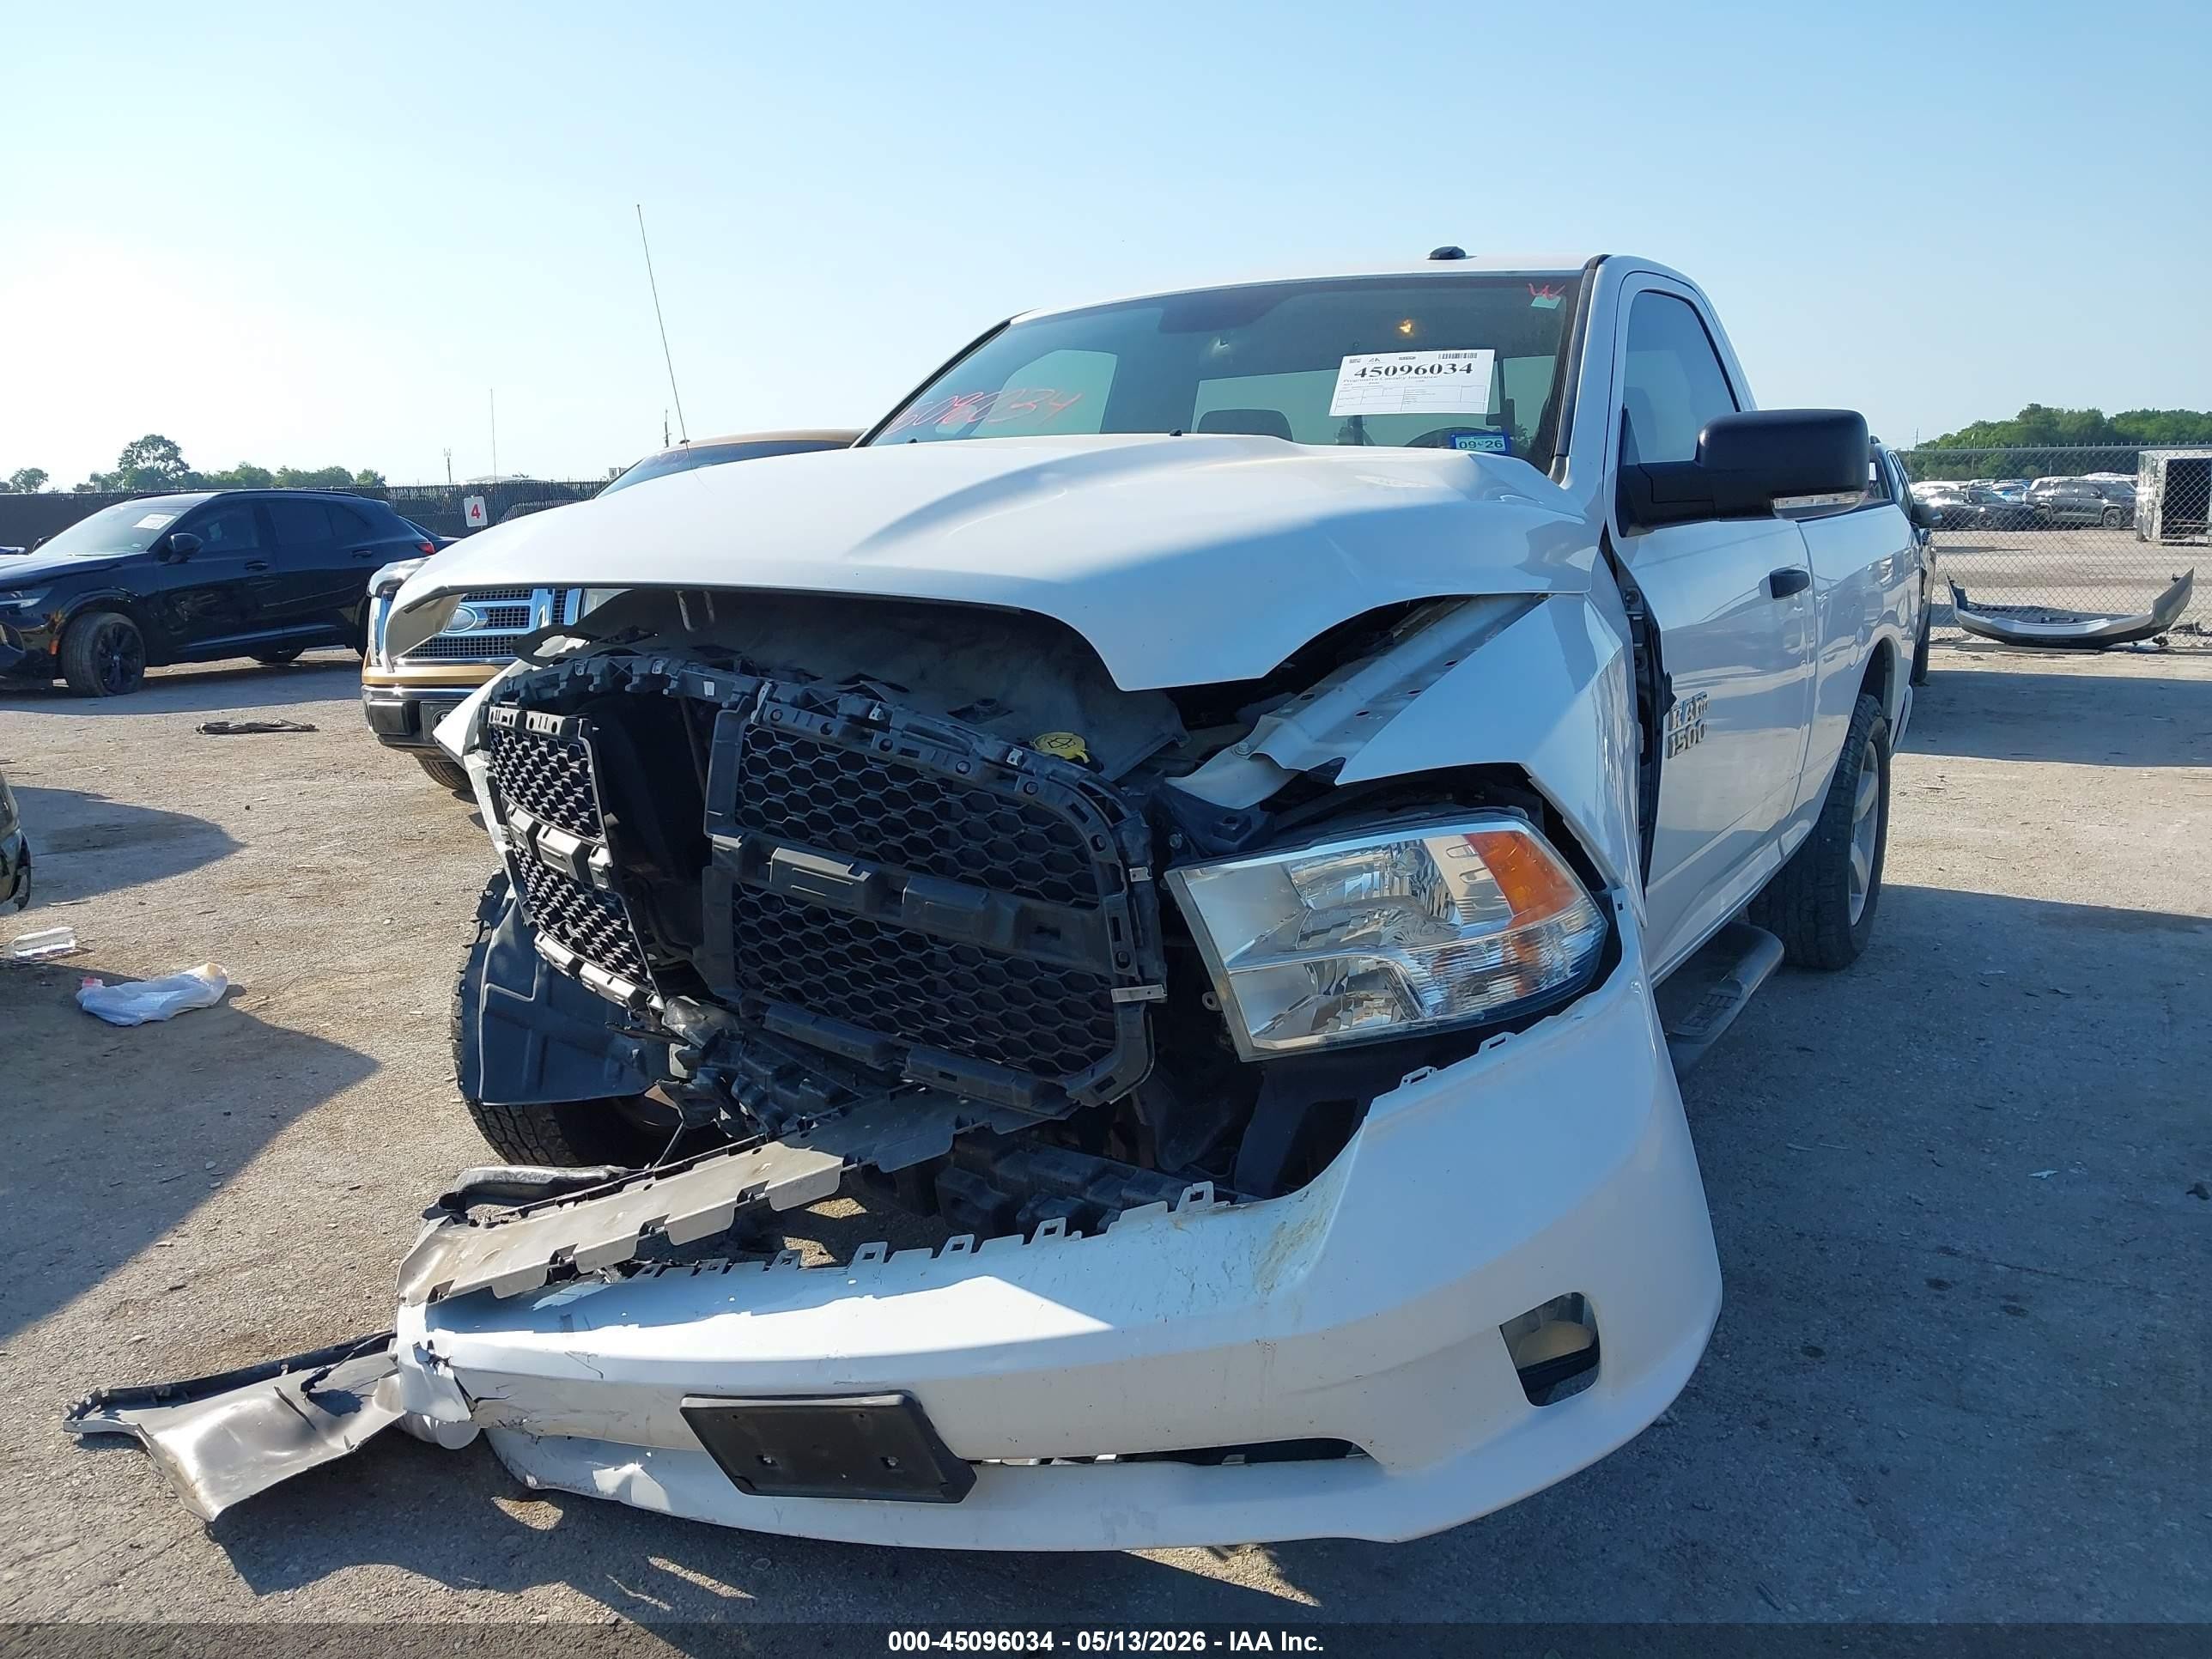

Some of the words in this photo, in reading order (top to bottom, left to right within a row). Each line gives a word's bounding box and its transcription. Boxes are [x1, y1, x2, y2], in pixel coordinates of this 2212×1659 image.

[1354, 362, 1474, 378] 45096034
[1459, 441, 1477, 449] 09
[1485, 440, 1504, 448] 26
[471, 503, 481, 519] 4
[1668, 691, 1708, 731] RAM
[1668, 719, 1708, 760] 1500
